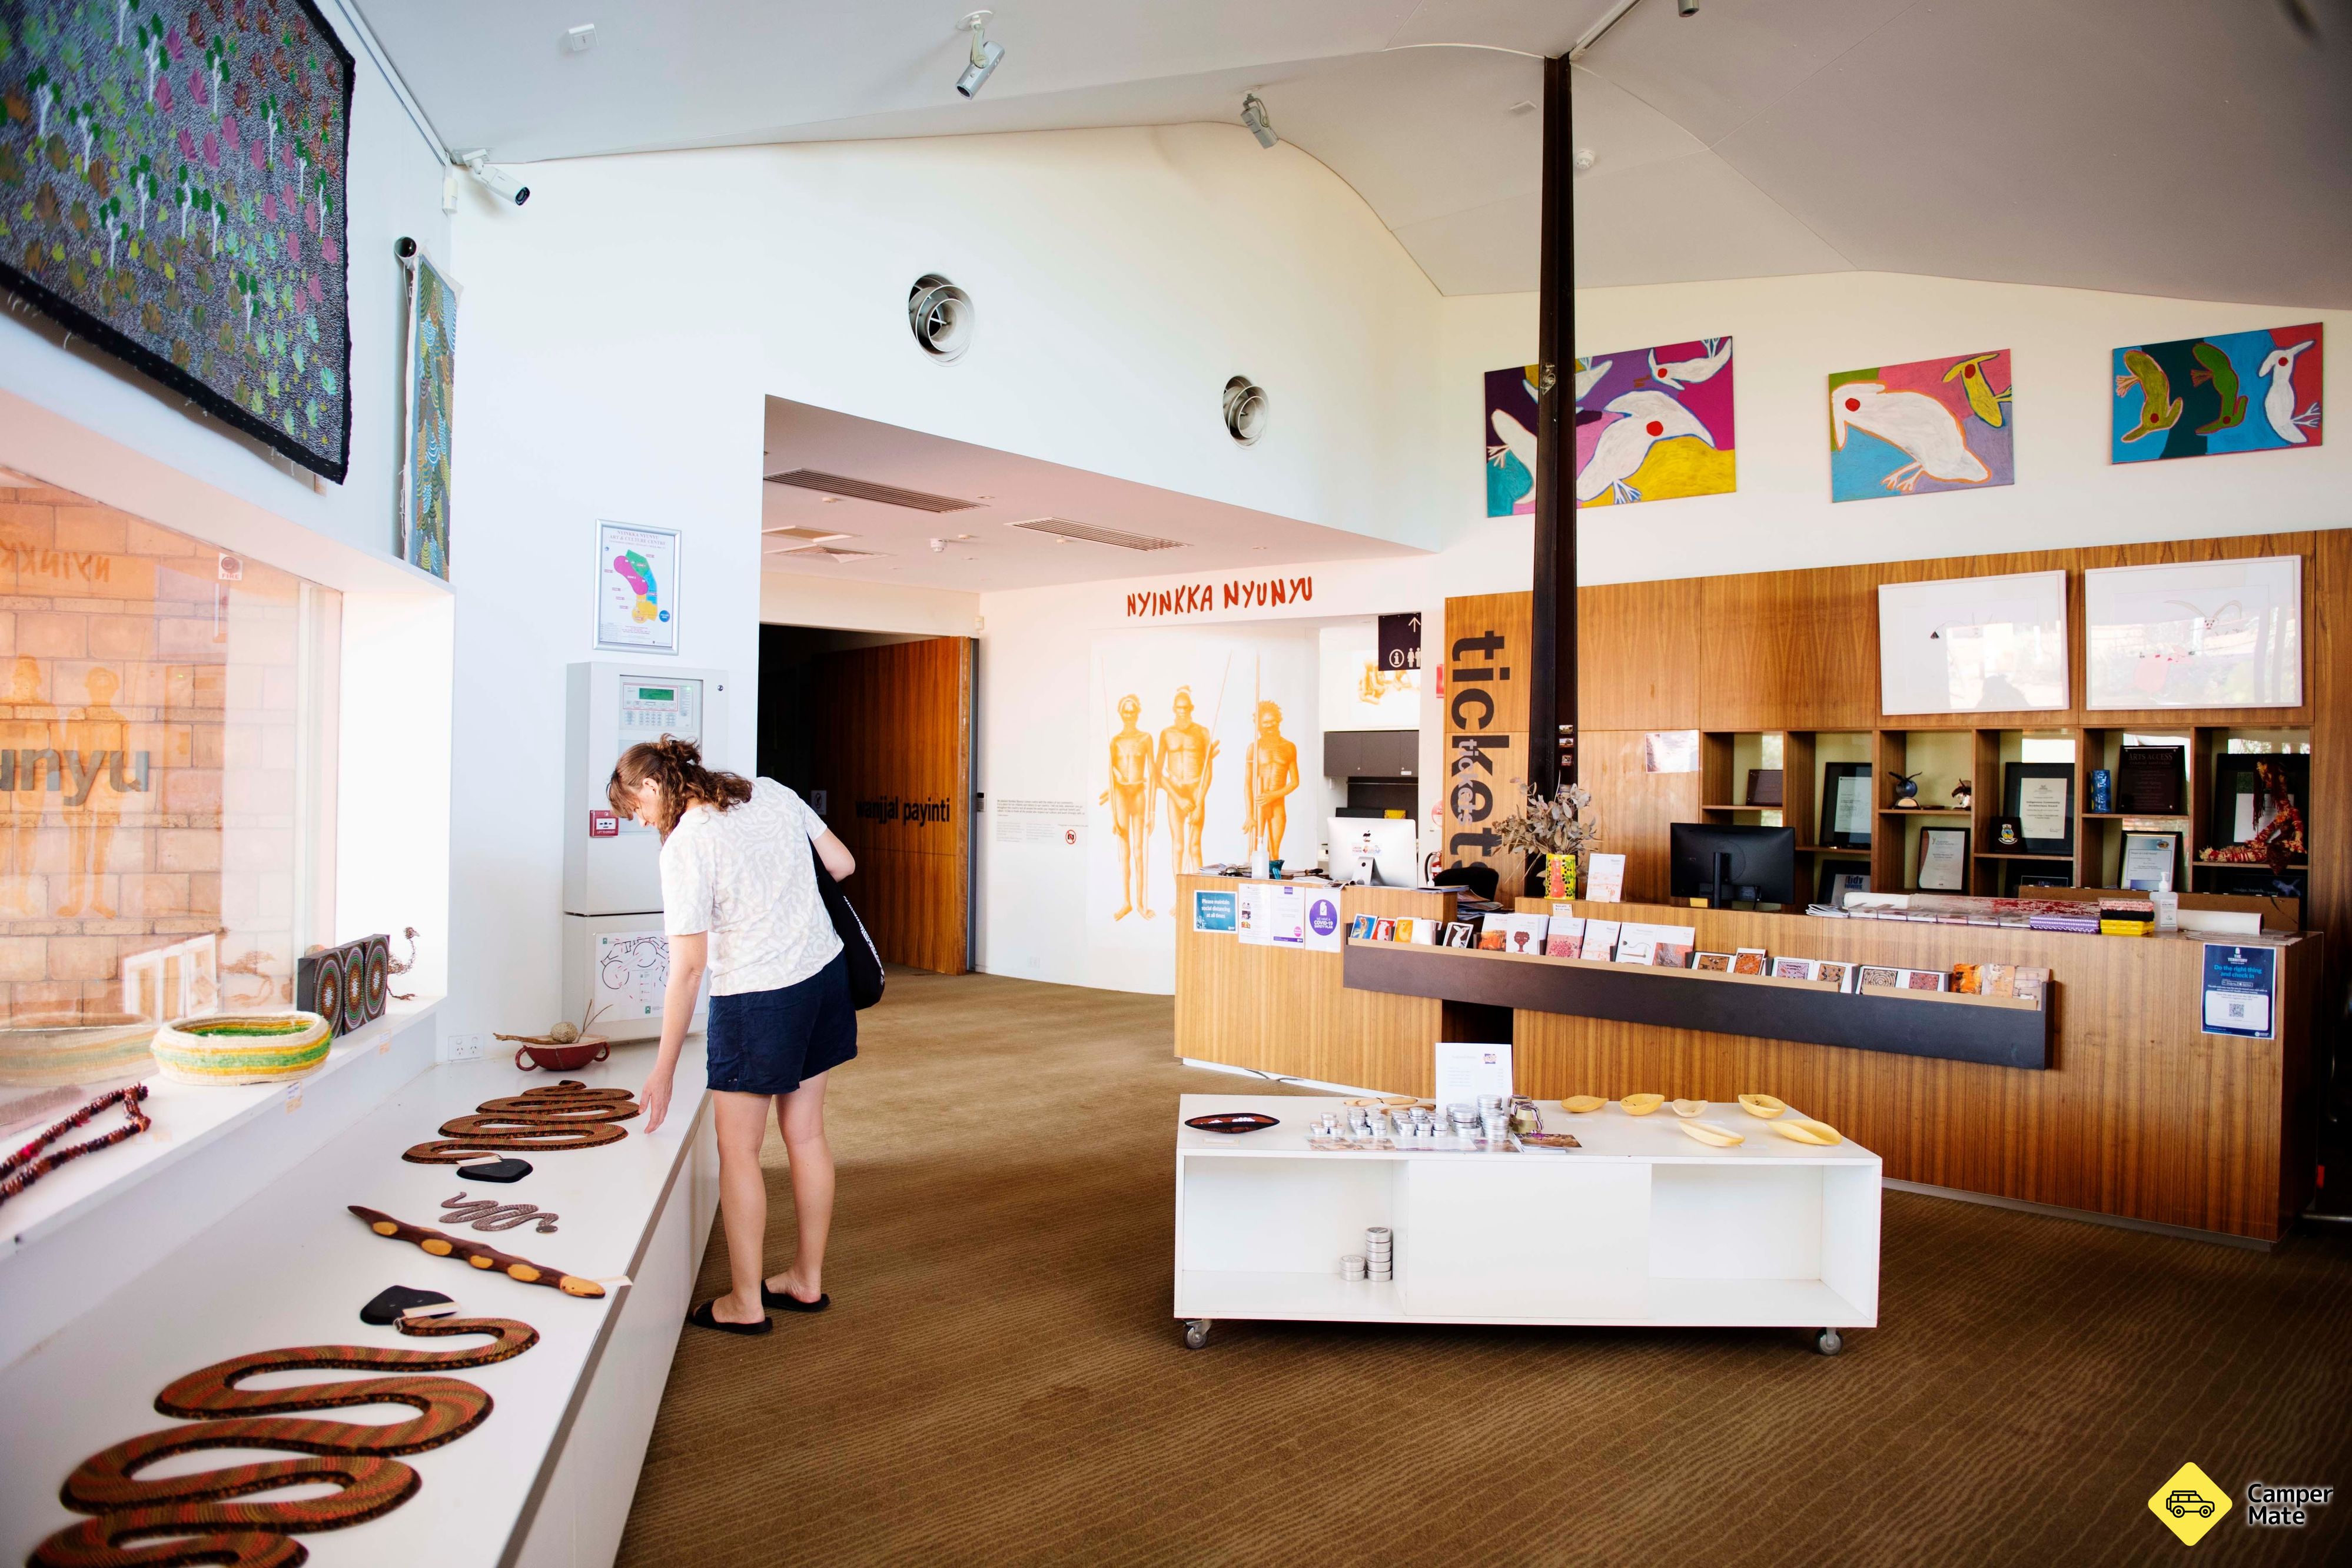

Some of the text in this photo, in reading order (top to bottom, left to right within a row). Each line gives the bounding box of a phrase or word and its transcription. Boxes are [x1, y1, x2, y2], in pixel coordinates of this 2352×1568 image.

[1127, 576, 1313, 617] NYINKKA NYUNYU
[1458, 739, 1479, 826] tickets
[903, 797, 949, 826] payinti
